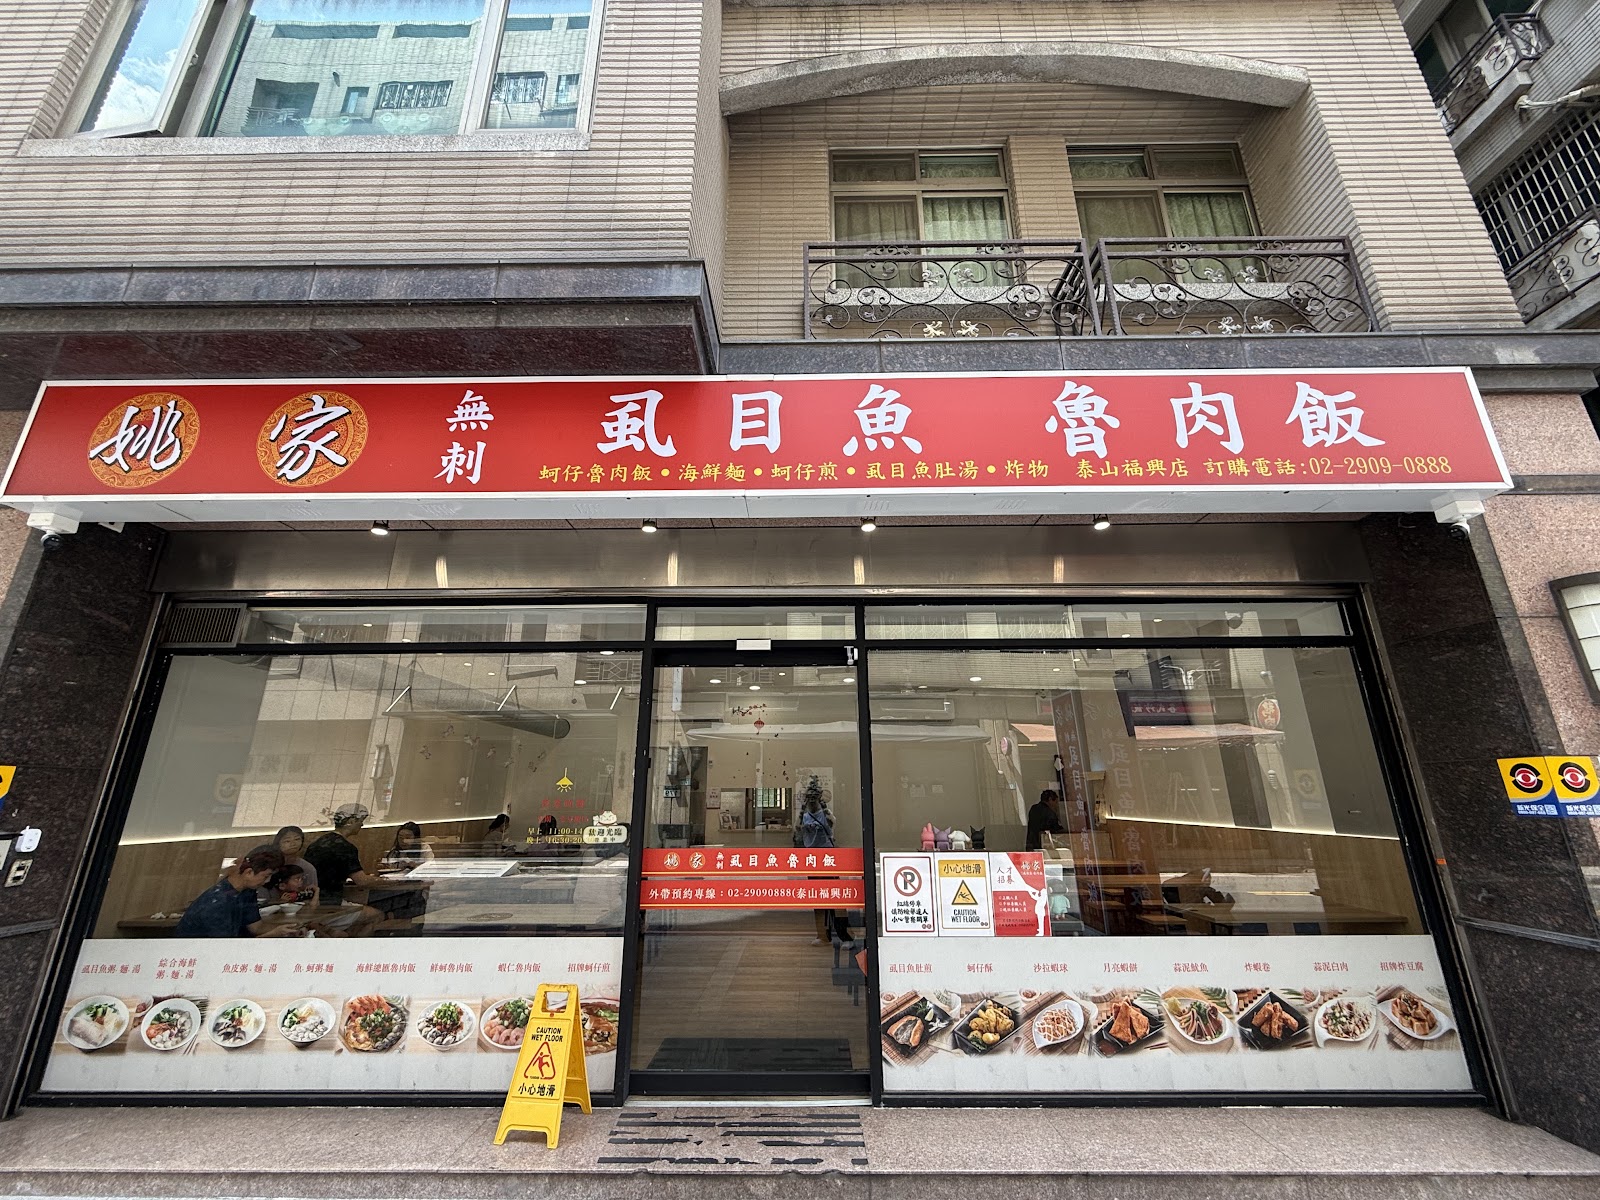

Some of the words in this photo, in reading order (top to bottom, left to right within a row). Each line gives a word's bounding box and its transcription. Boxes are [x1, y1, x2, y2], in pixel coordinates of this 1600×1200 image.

[596, 383, 923, 458] 虱目魚
[1044, 380, 1386, 460] 魯肉飯
[434, 389, 495, 485] 無刺
[538, 463, 654, 484] 蚵仔魯肉飯
[678, 463, 747, 483] 海鮮麵
[770, 463, 839, 482] 蚵仔煎
[865, 459, 979, 482] 虱目魚肚湯
[1005, 457, 1050, 480] 炸物
[1076, 456, 1190, 479] 泰山福興店
[730, 853, 779, 868] 虱目魚
[787, 853, 837, 868] 魯肉飯
[943, 863, 982, 875] 小心地滑
[996, 866, 1013, 874] 人才
[996, 875, 1015, 885] 招募
[953, 908, 977, 916] CAUTION
[951, 915, 962, 923] WET
[962, 915, 981, 923] FLOOR
[497, 962, 542, 973] 蝦仁魯肉飯
[567, 962, 611, 973] 招牌蚵仔煎
[966, 962, 994, 973] 蚵仔酥
[1033, 962, 1069, 973] 沙拉蝦球
[1103, 962, 1139, 973] 月亮蝦餅
[1313, 961, 1349, 972] 蒜泥白肉
[1380, 961, 1425, 972] 招牌炸豆腐
[536, 1027, 562, 1035] CAUTION
[544, 1034, 563, 1043] FLOOR
[518, 1082, 556, 1097] 小心地滑
